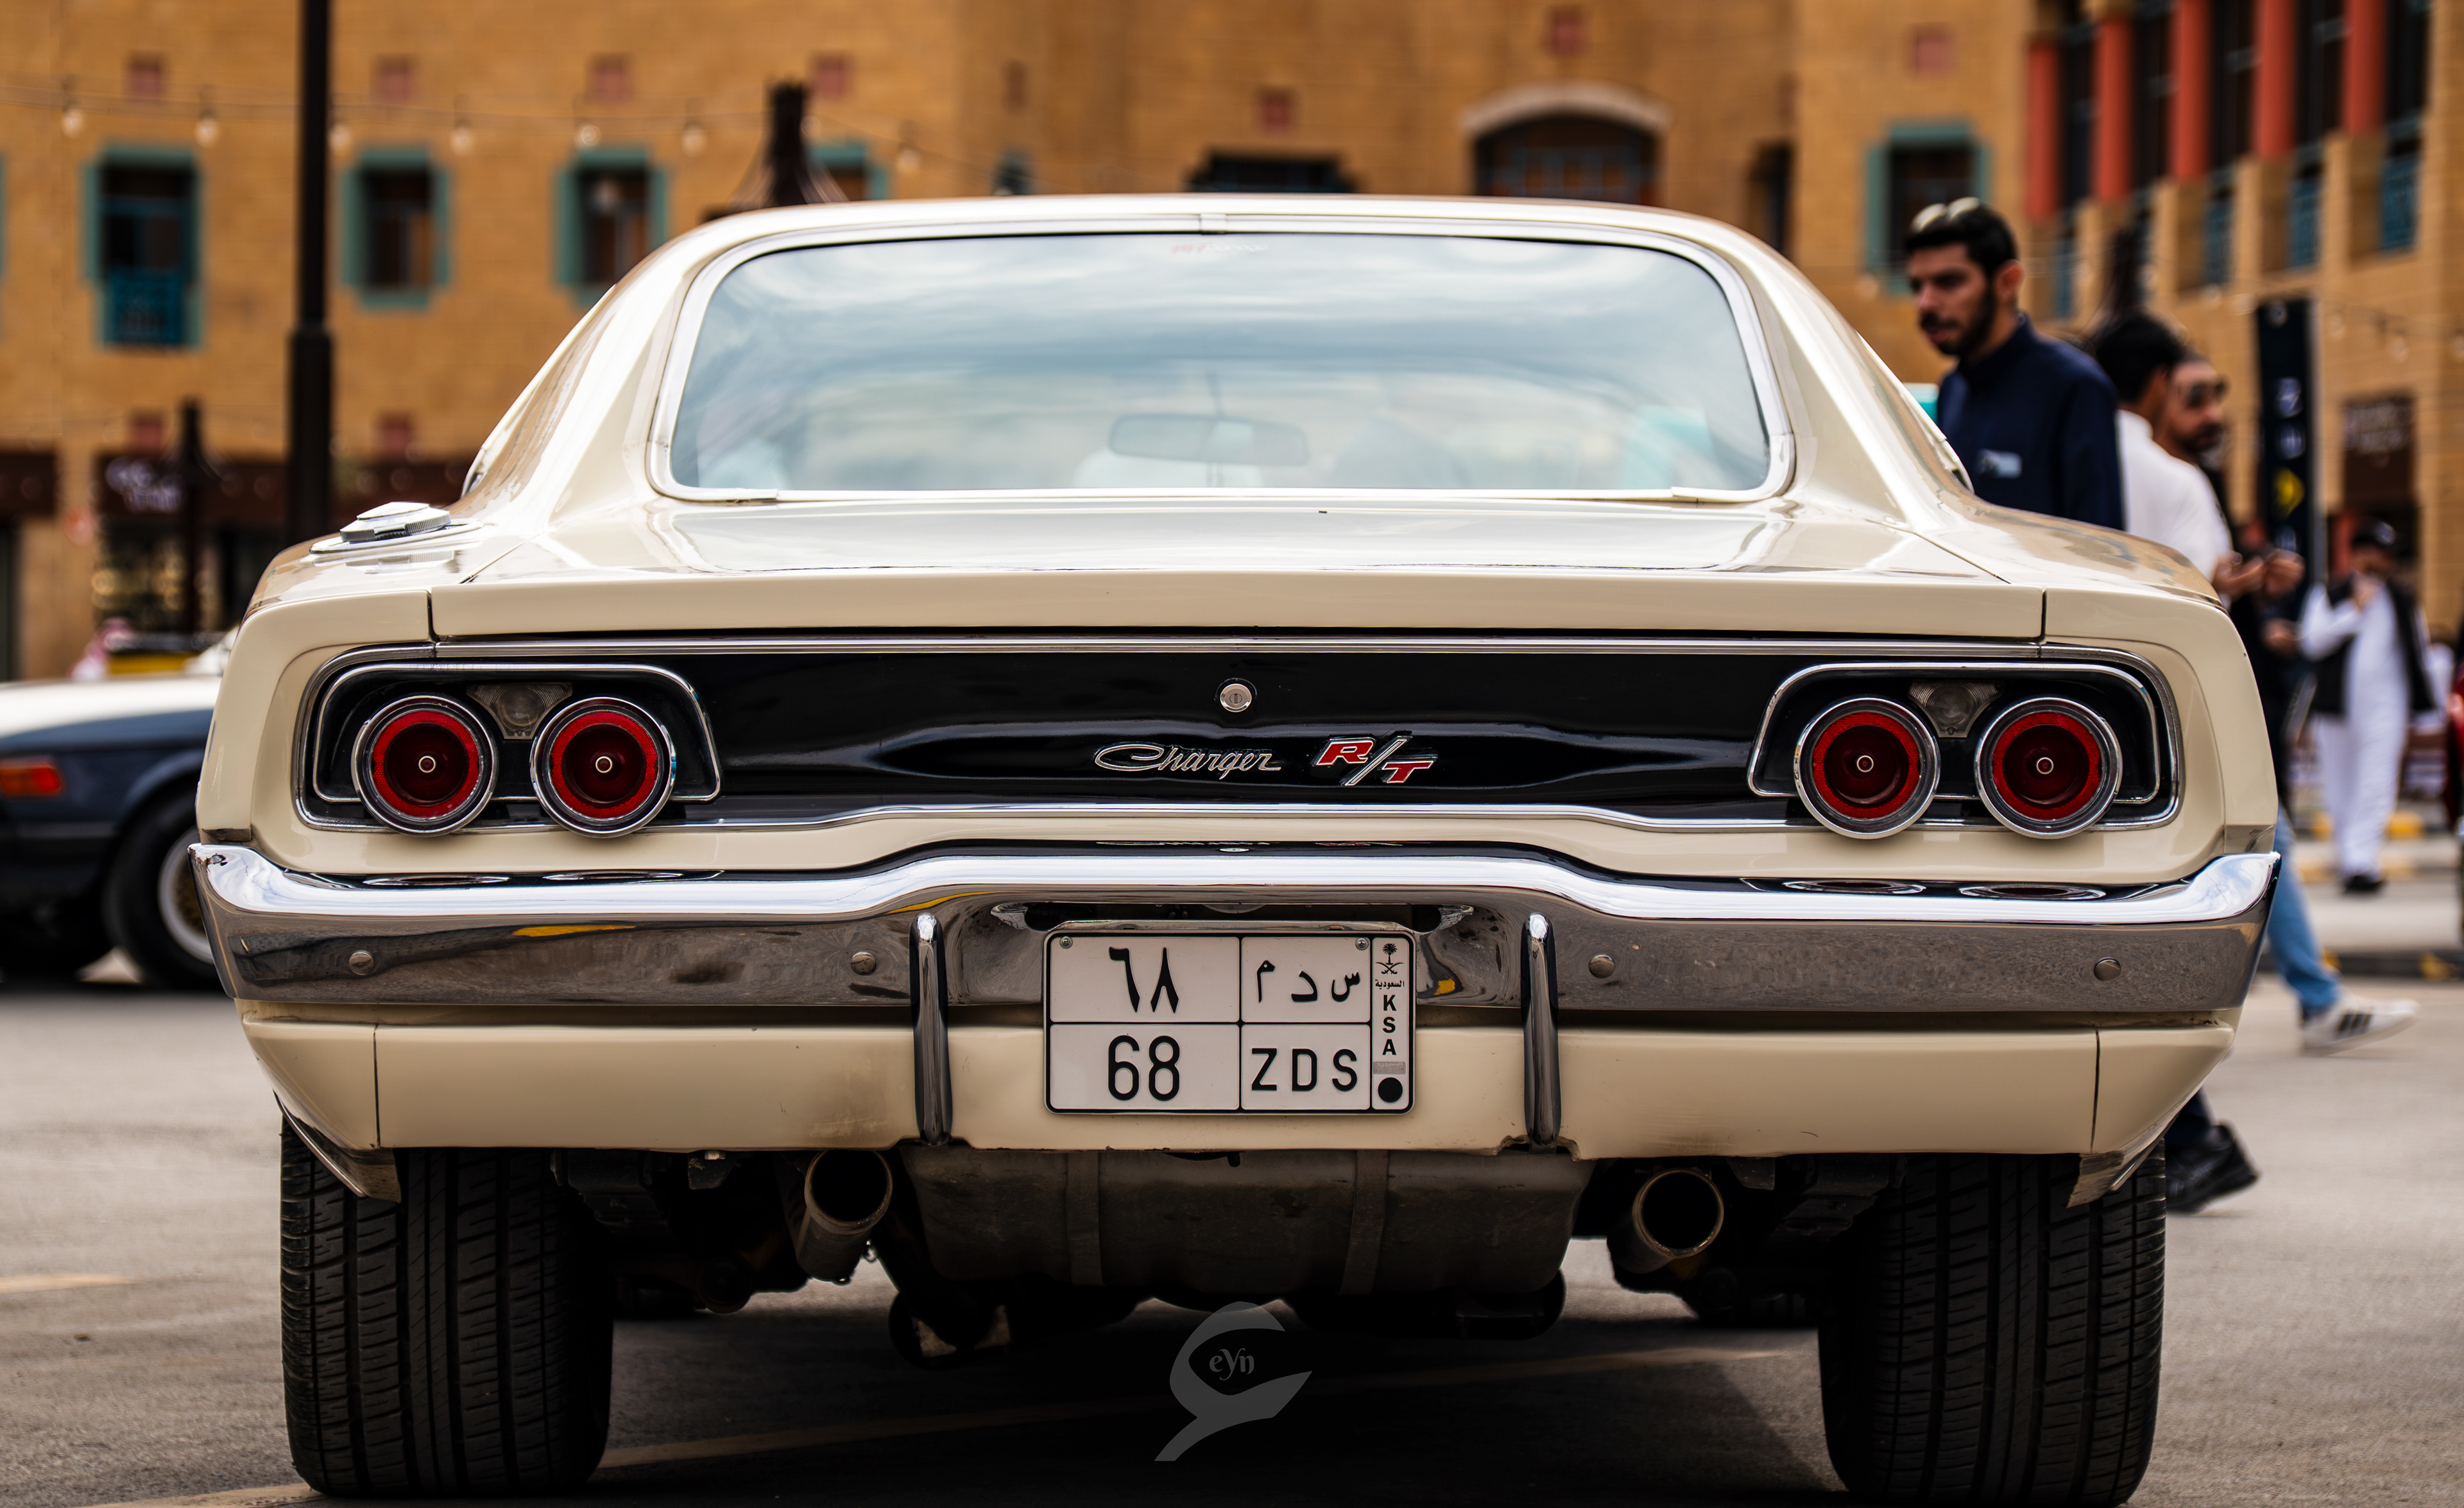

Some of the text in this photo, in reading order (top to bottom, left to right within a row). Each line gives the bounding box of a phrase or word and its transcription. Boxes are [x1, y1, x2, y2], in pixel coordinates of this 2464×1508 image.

[1093, 732, 1437, 786] Charger R/T
[1109, 947, 1180, 1013] ٦٨
[1374, 979, 1405, 989] السعودية
[1108, 1035, 1180, 1101] 68
